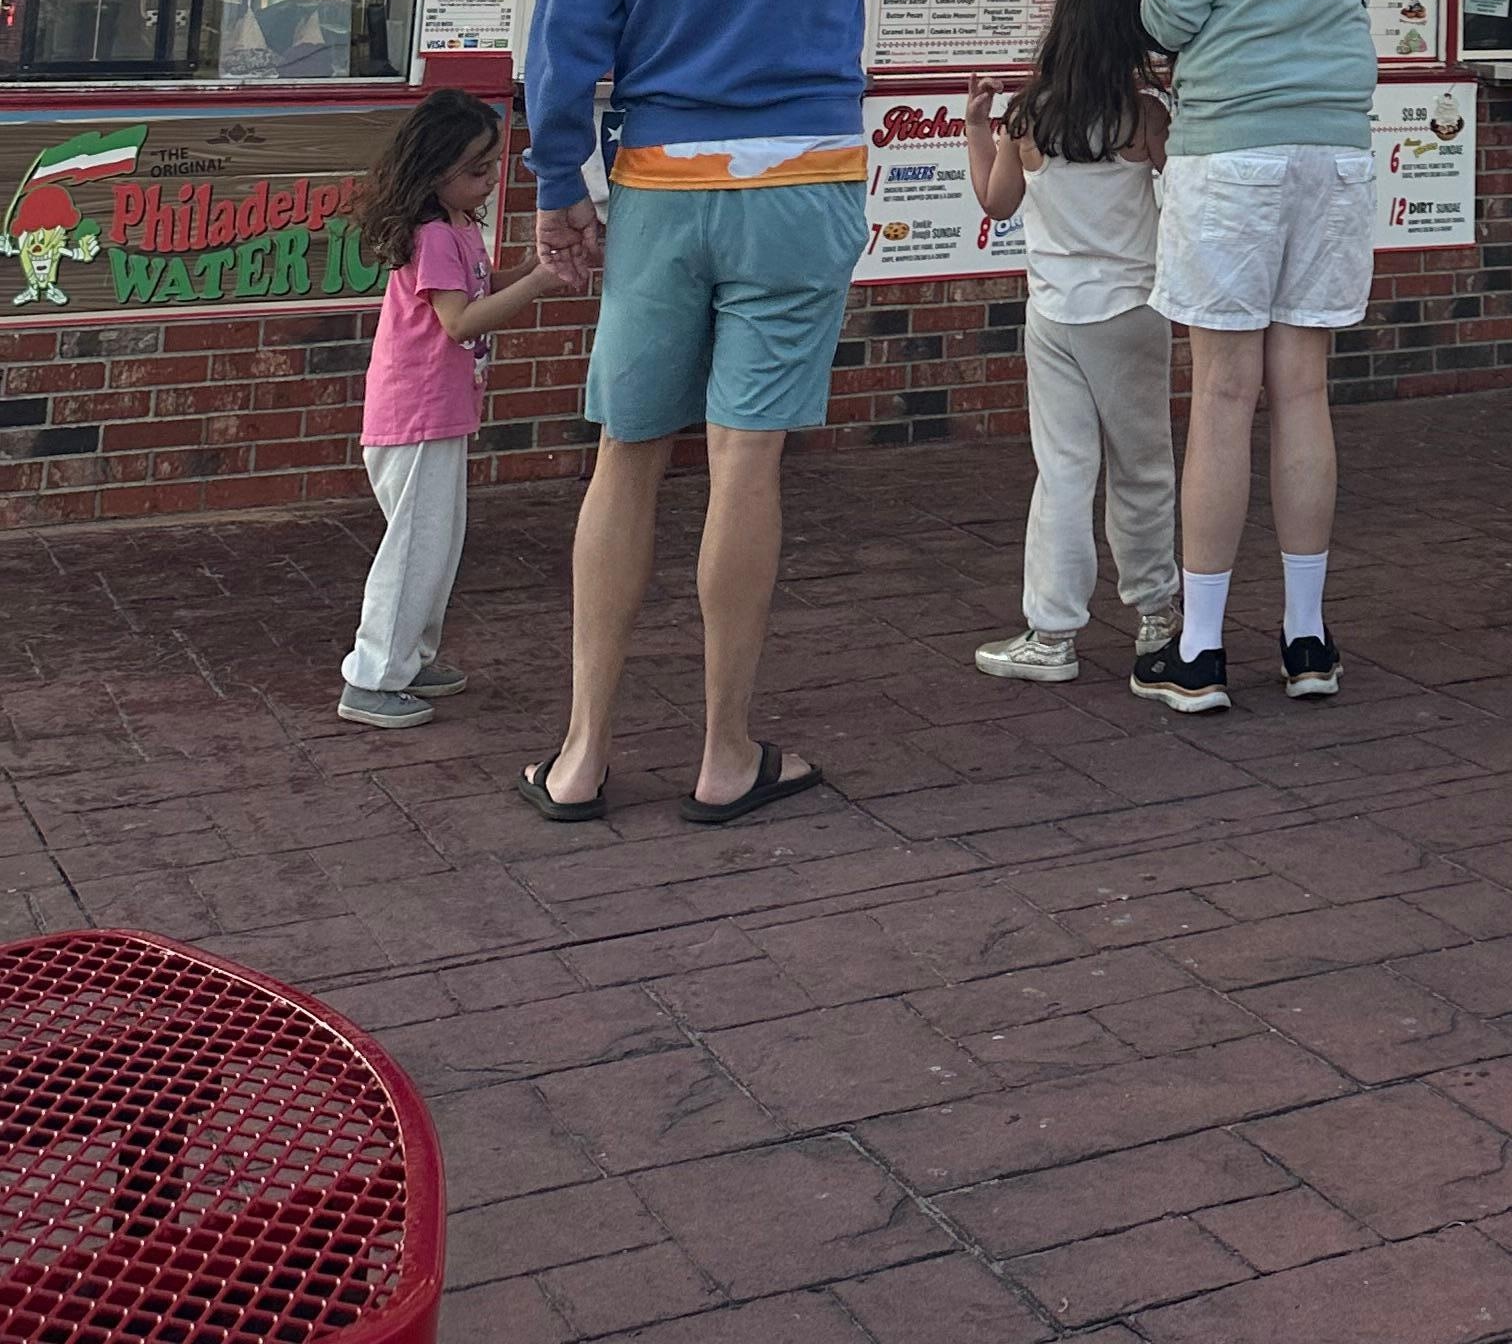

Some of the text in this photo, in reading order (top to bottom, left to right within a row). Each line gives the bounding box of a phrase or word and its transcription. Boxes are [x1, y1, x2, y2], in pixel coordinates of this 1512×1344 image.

[1402, 108, 1428, 121] $9.99
[150, 147, 189, 163] "THE
[150, 156, 232, 179] ORIGINAL"
[1390, 143, 1401, 173] 6
[888, 165, 936, 182] SNICKERS
[937, 170, 966, 181] SUNDAE
[109, 177, 358, 254] Philadelp
[1389, 197, 1407, 226] 12
[1409, 202, 1434, 214] DIRT
[868, 223, 882, 255] 7
[932, 227, 961, 238] SUNDAE
[977, 216, 991, 249] 8
[108, 218, 387, 306] WATER IC
